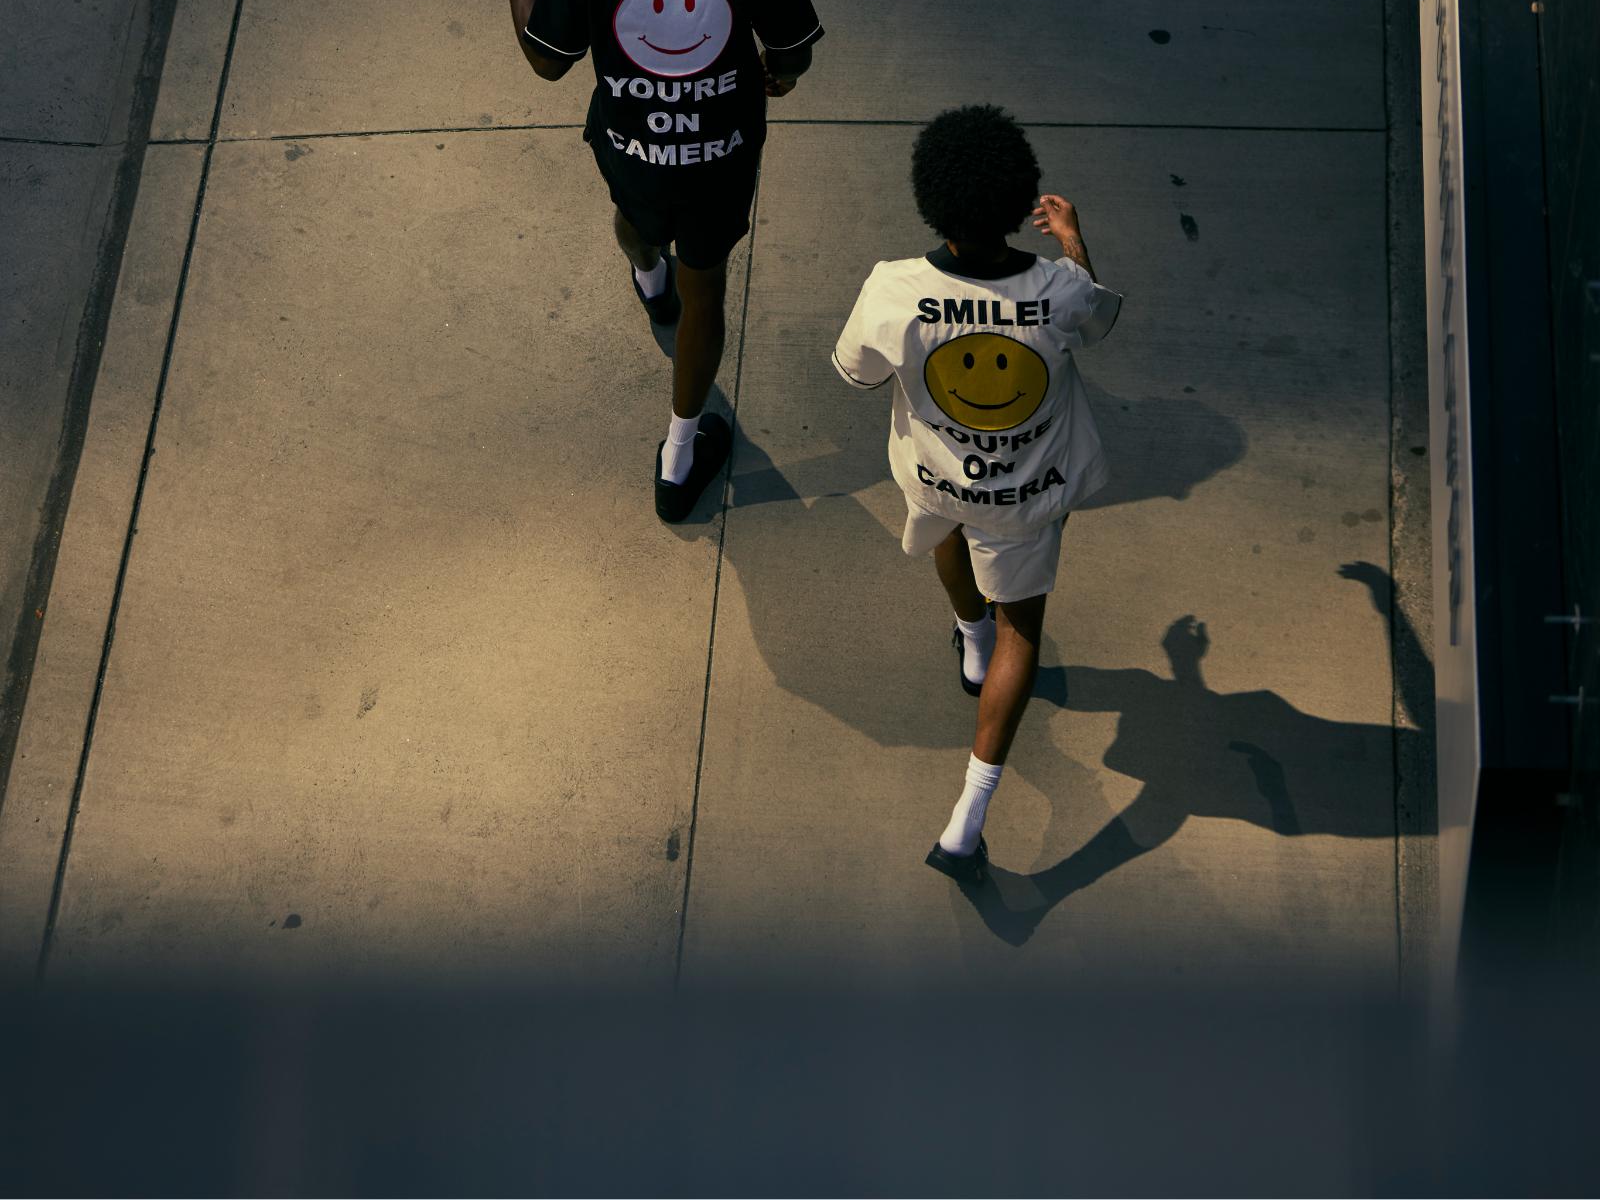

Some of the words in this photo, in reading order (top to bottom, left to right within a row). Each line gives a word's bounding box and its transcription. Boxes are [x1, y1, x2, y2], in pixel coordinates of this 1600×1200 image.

[646, 111, 700, 133] ON
[606, 128, 743, 166] CAMERA
[917, 297, 1050, 326] SMILE!
[963, 454, 1016, 480] ON
[917, 463, 1066, 506] CAMERA
